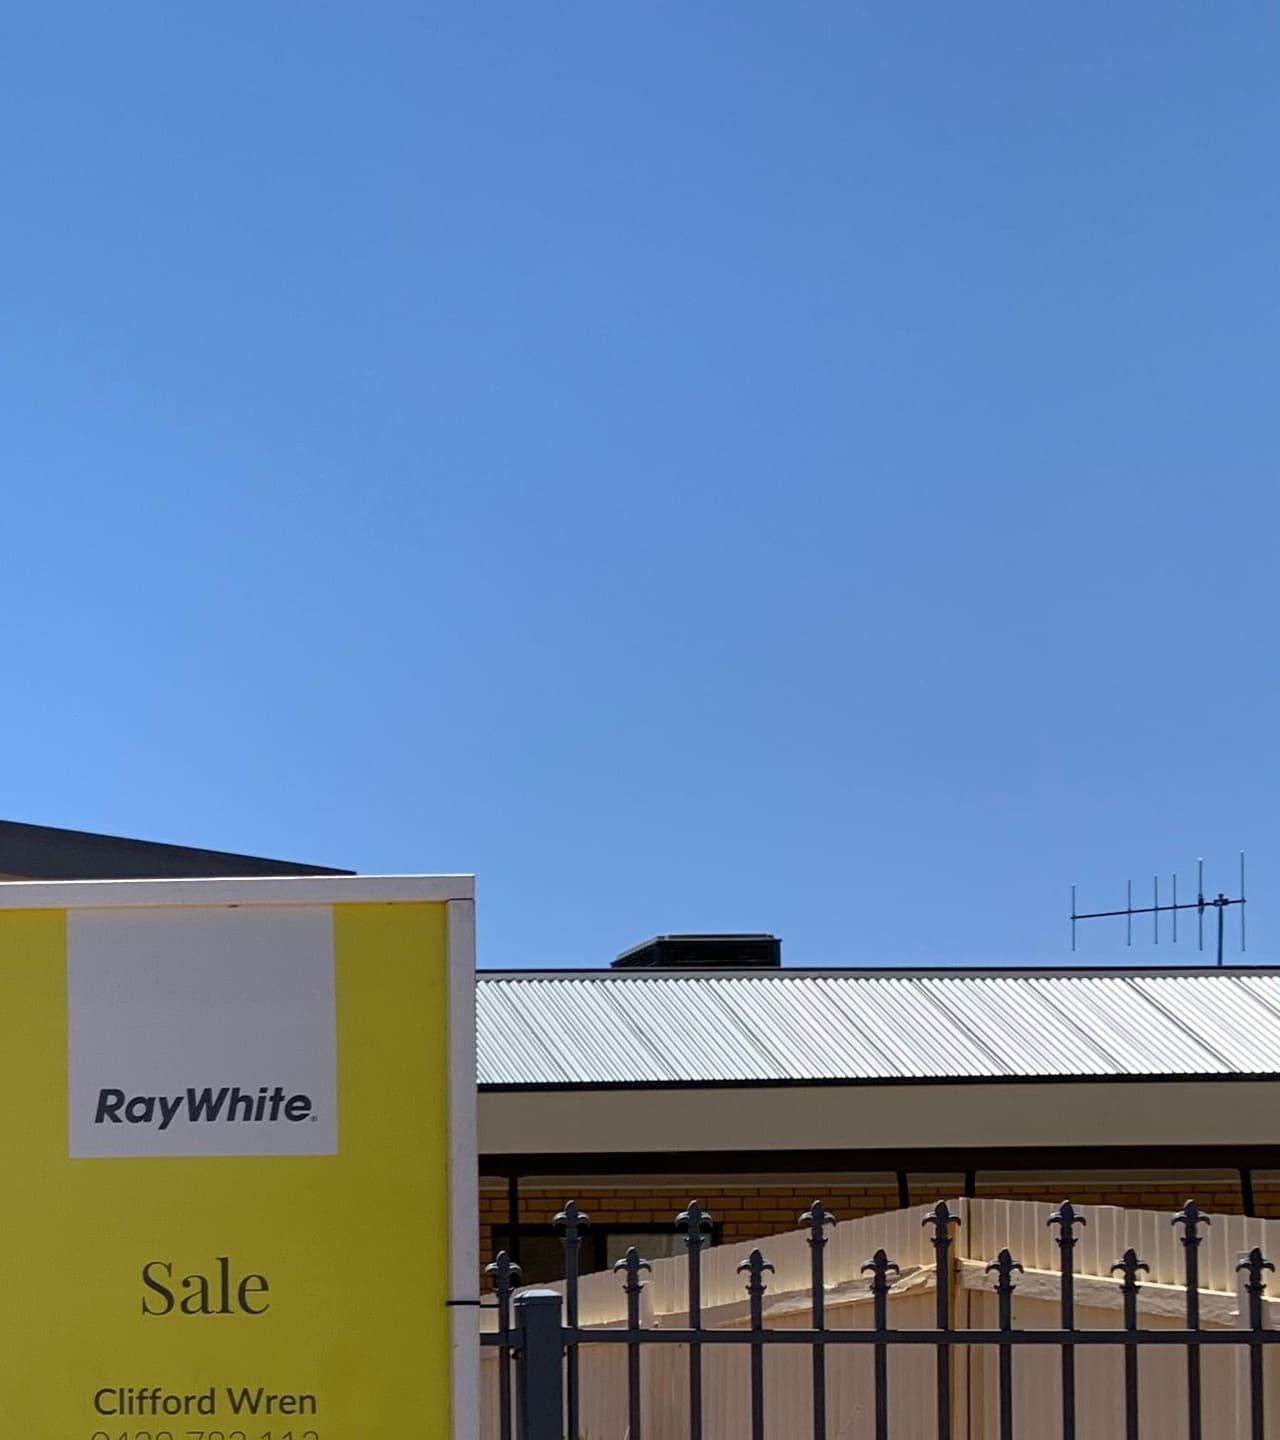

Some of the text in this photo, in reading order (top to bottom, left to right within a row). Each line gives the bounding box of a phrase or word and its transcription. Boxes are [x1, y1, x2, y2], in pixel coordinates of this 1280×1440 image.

[141, 1256, 270, 1316] Sale
[93, 1386, 317, 1416] Clifford Wren
